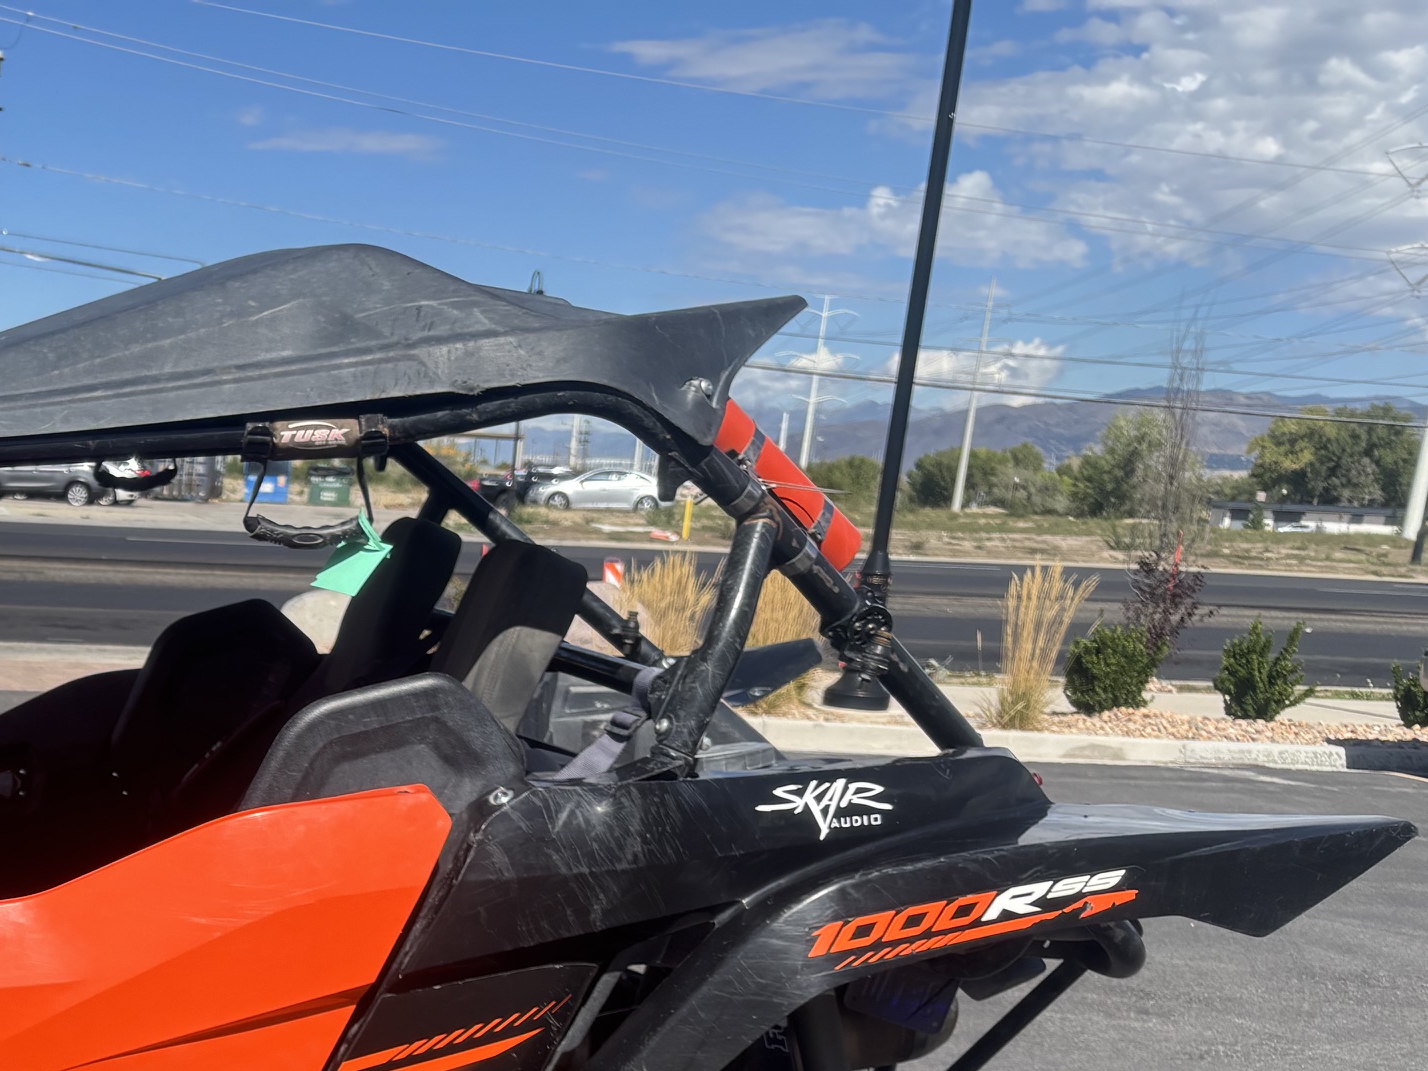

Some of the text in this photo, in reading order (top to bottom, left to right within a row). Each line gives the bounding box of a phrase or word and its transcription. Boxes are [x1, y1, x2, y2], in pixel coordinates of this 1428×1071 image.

[280, 428, 351, 443] TUSK
[755, 778, 893, 841] SKAR
[830, 814, 882, 828] AUDIO
